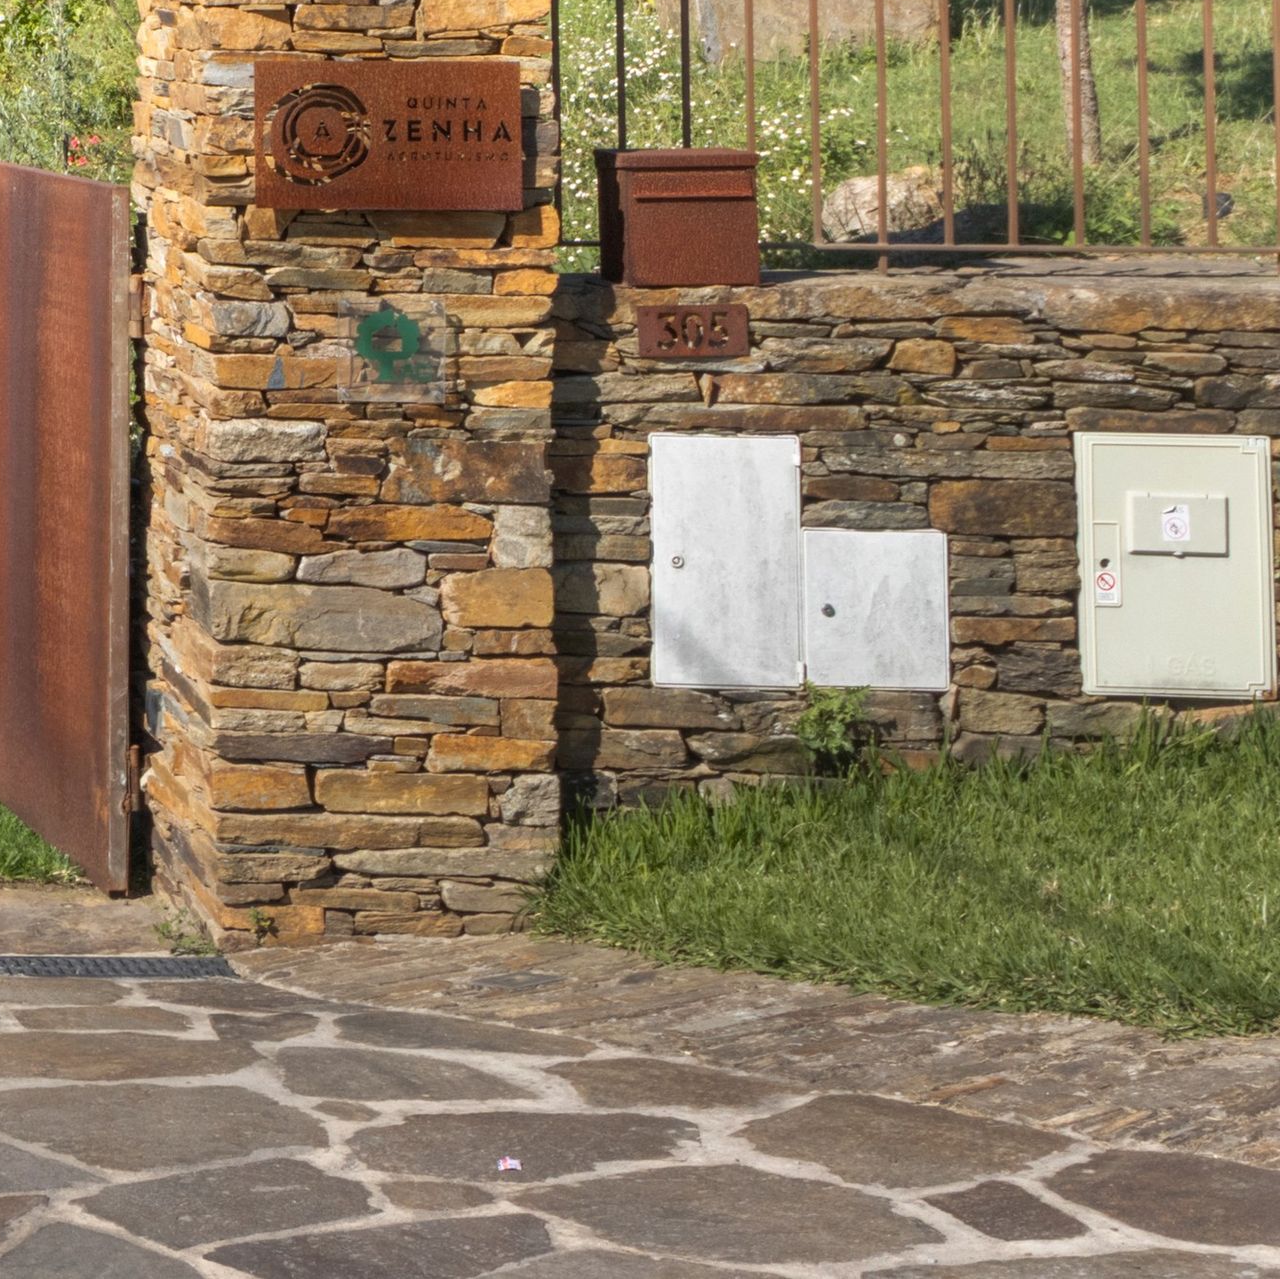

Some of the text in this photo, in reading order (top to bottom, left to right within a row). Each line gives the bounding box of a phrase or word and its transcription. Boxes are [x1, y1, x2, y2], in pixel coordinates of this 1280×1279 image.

[407, 97, 487, 110] QUINTA
[382, 120, 513, 142] ZENHA
[657, 312, 729, 350] 305
